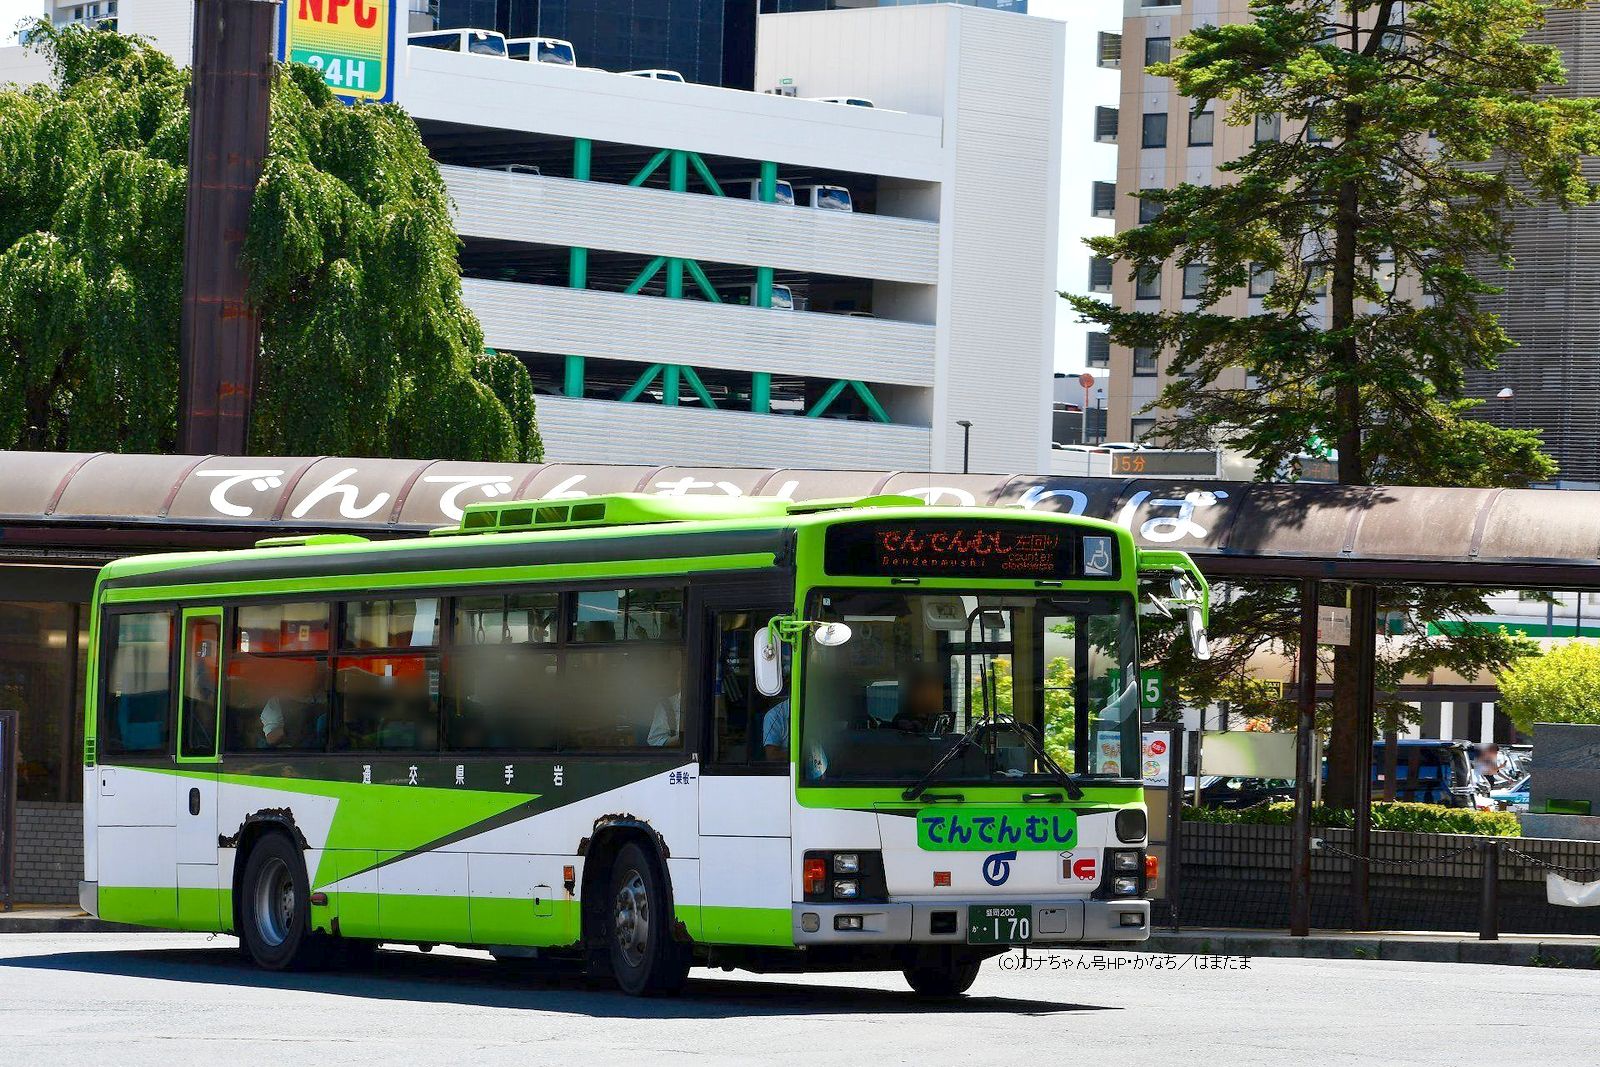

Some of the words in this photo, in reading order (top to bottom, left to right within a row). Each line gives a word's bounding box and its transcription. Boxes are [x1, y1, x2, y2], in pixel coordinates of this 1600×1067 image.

[878, 529, 1012, 555] でんでんむし
[921, 815, 1074, 844] でんでんむし
